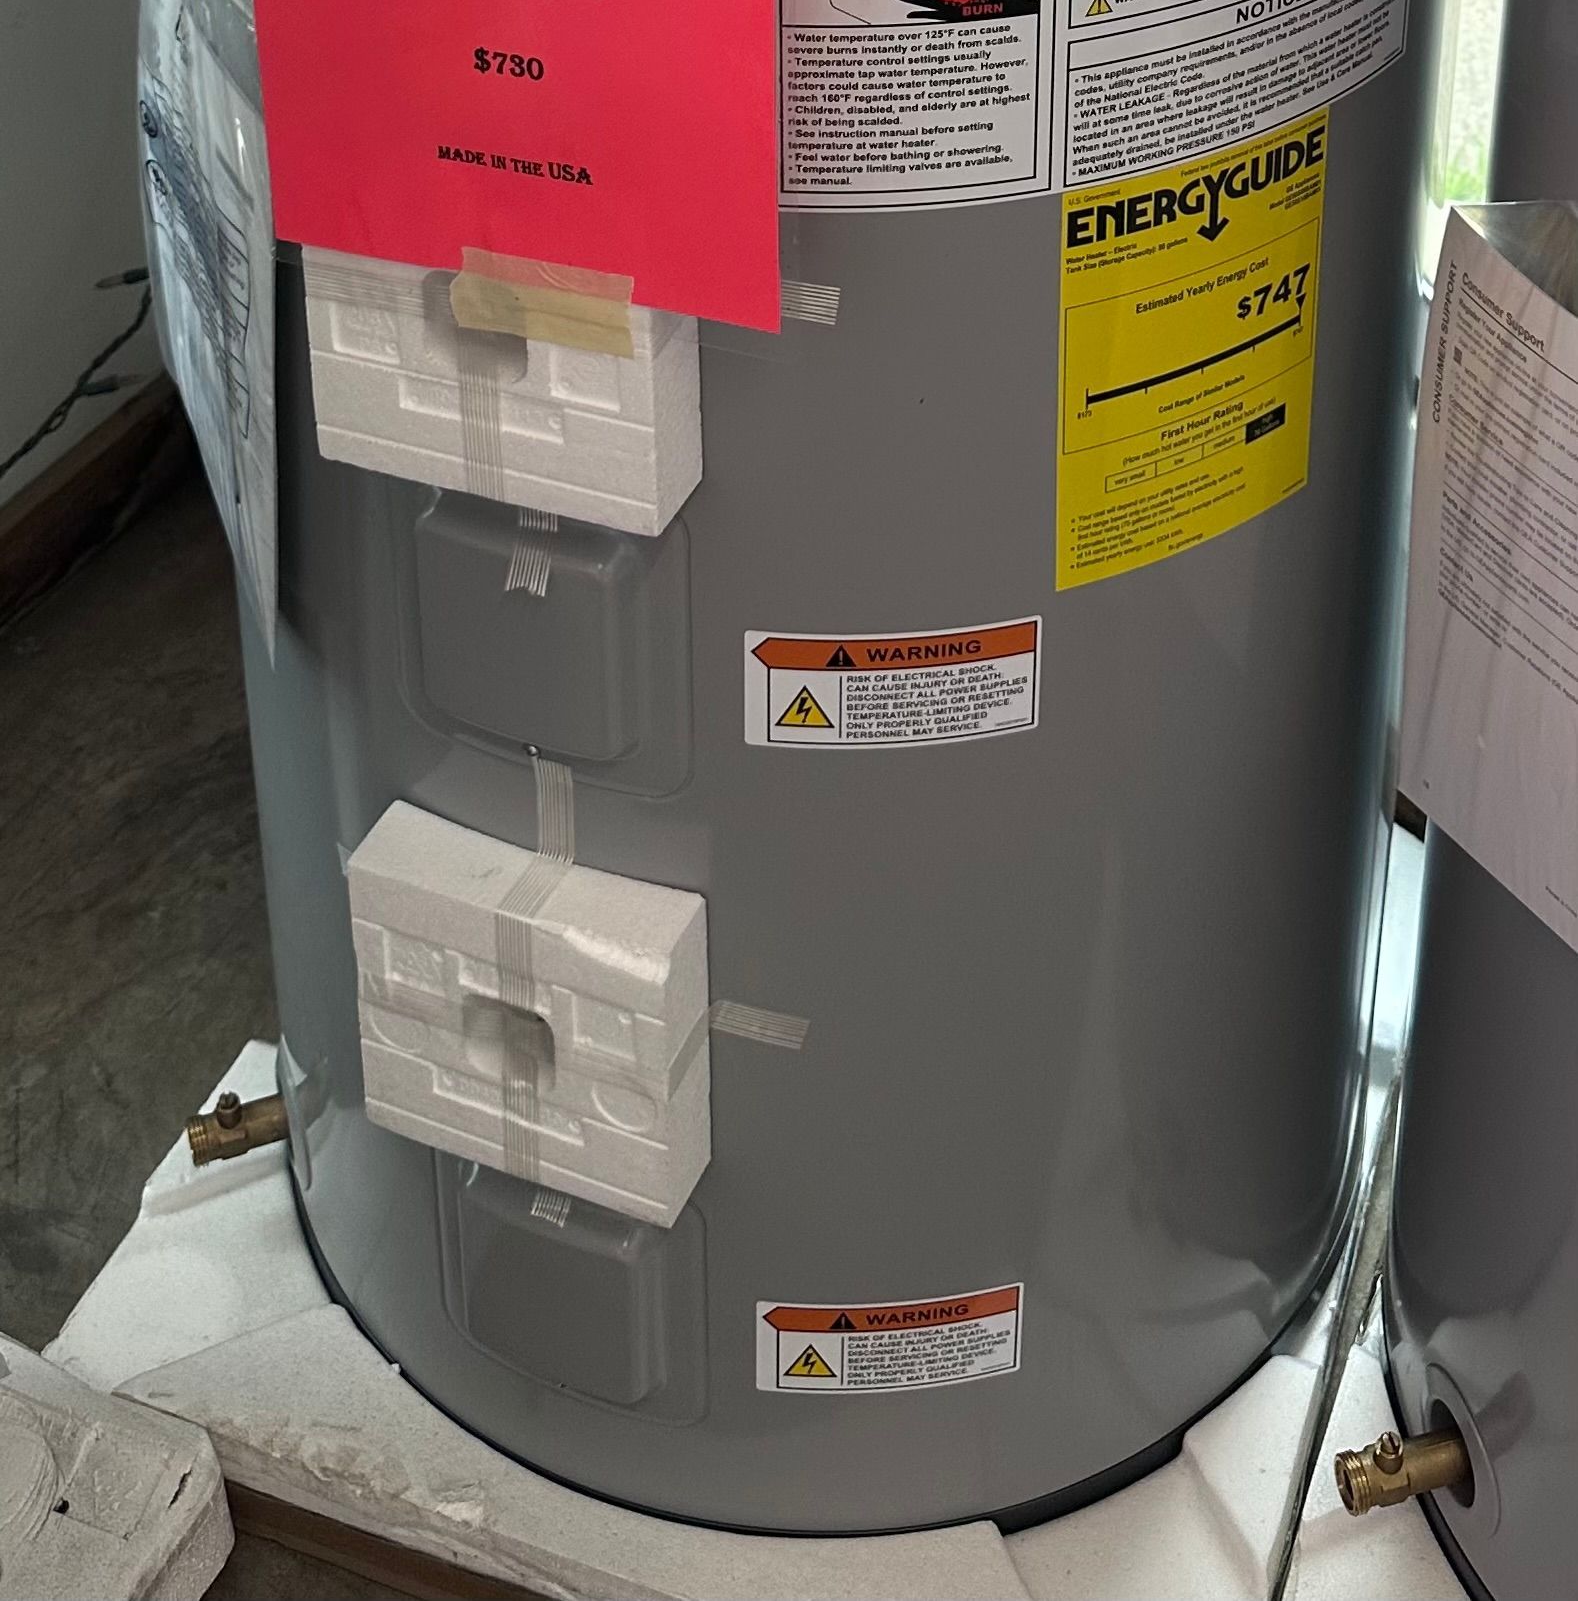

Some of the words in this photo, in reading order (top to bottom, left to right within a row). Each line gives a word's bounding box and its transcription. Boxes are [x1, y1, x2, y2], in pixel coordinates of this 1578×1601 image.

[962, 3, 1003, 16] BURN
[788, 46, 823, 55] severe
[827, 45, 858, 55] burns
[862, 43, 907, 55] instantly
[911, 44, 922, 52] or
[925, 41, 955, 51] death
[958, 39, 982, 48] from
[985, 35, 1022, 47] scalds.
[794, 34, 826, 44] Water
[829, 32, 895, 44] temperature
[898, 31, 922, 40] over
[925, 29, 955, 39] 125°F
[958, 27, 977, 36] can
[979, 24, 1011, 35] cause
[473, 46, 544, 81] $730
[795, 57, 863, 68] Temperature
[866, 55, 905, 65] control
[908, 53, 950, 65] settings
[795, 104, 844, 115] Children,
[847, 103, 896, 114] disabled,
[1080, 104, 1117, 118] WATER
[1119, 93, 1165, 109] LEAKAGE
[1078, 158, 1126, 176] MAXIMUM
[1128, 147, 1174, 165] WORKING
[1176, 131, 1224, 153] PRESSURE
[1242, 120, 1256, 133] PSI
[437, 145, 487, 166] MADE
[490, 154, 507, 170] IN
[510, 157, 545, 178] THE
[548, 161, 594, 185] USA
[1066, 124, 1326, 248] ENERGYGUIDE
[1136, 291, 1184, 314] Estimated
[1186, 280, 1214, 300] Yearly
[1216, 267, 1248, 288] Energy
[1249, 257, 1269, 274] Cost
[1236, 262, 1311, 319] $747
[1462, 272, 1505, 318] Consumer
[1506, 312, 1545, 353] Support
[1433, 339, 1447, 423] CONSUMER
[1441, 260, 1458, 334] SUPPORT
[1160, 425, 1186, 442] First
[1189, 415, 1211, 433] Hour
[1213, 401, 1244, 423] Rating
[866, 640, 981, 663] WARNING
[846, 675, 871, 684] RISK
[875, 674, 889, 682] OF
[892, 668, 955, 682] ELECTRICAL
[846, 729, 909, 739] PERSONNEL
[912, 727, 934, 736] MAY
[866, 1303, 969, 1326] WARNING
